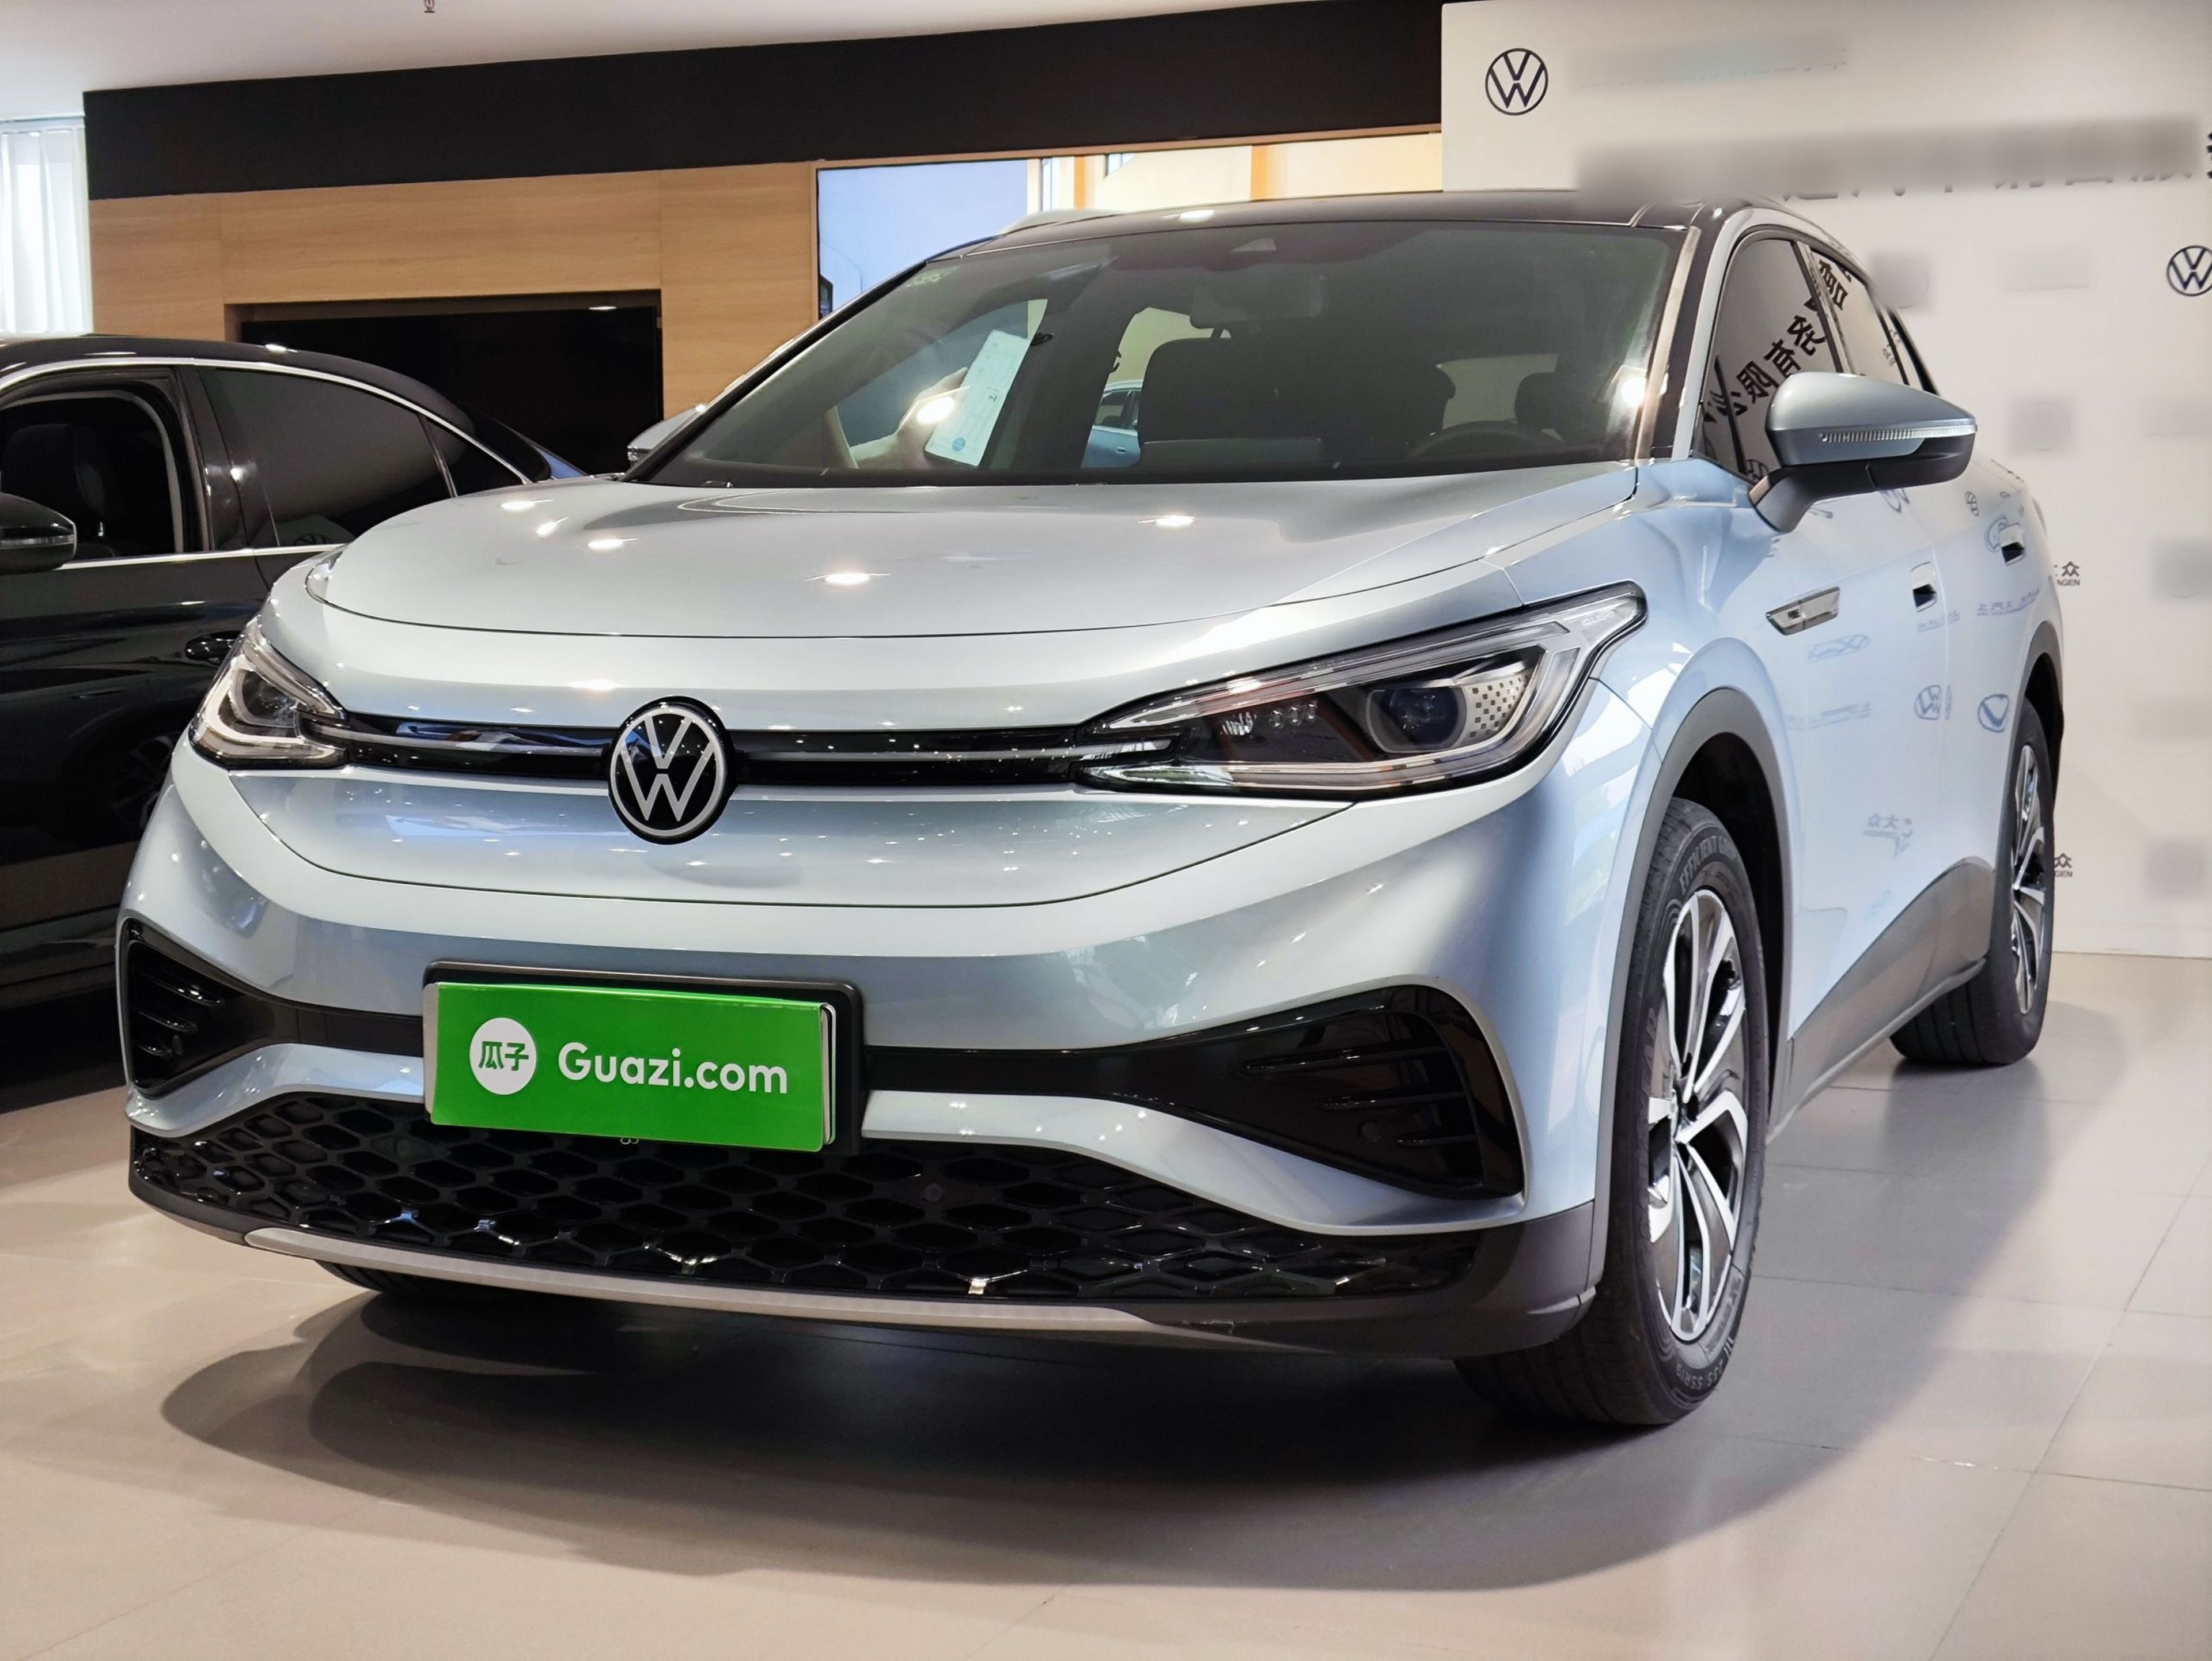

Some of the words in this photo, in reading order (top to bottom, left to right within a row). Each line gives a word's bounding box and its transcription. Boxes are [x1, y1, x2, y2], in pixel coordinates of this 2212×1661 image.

[1487, 50, 1546, 112] VW
[2053, 561, 2080, 577] 众
[615, 710, 719, 828] VW
[478, 1040, 529, 1072] 瓜子
[558, 1041, 788, 1095] Guazi.com
